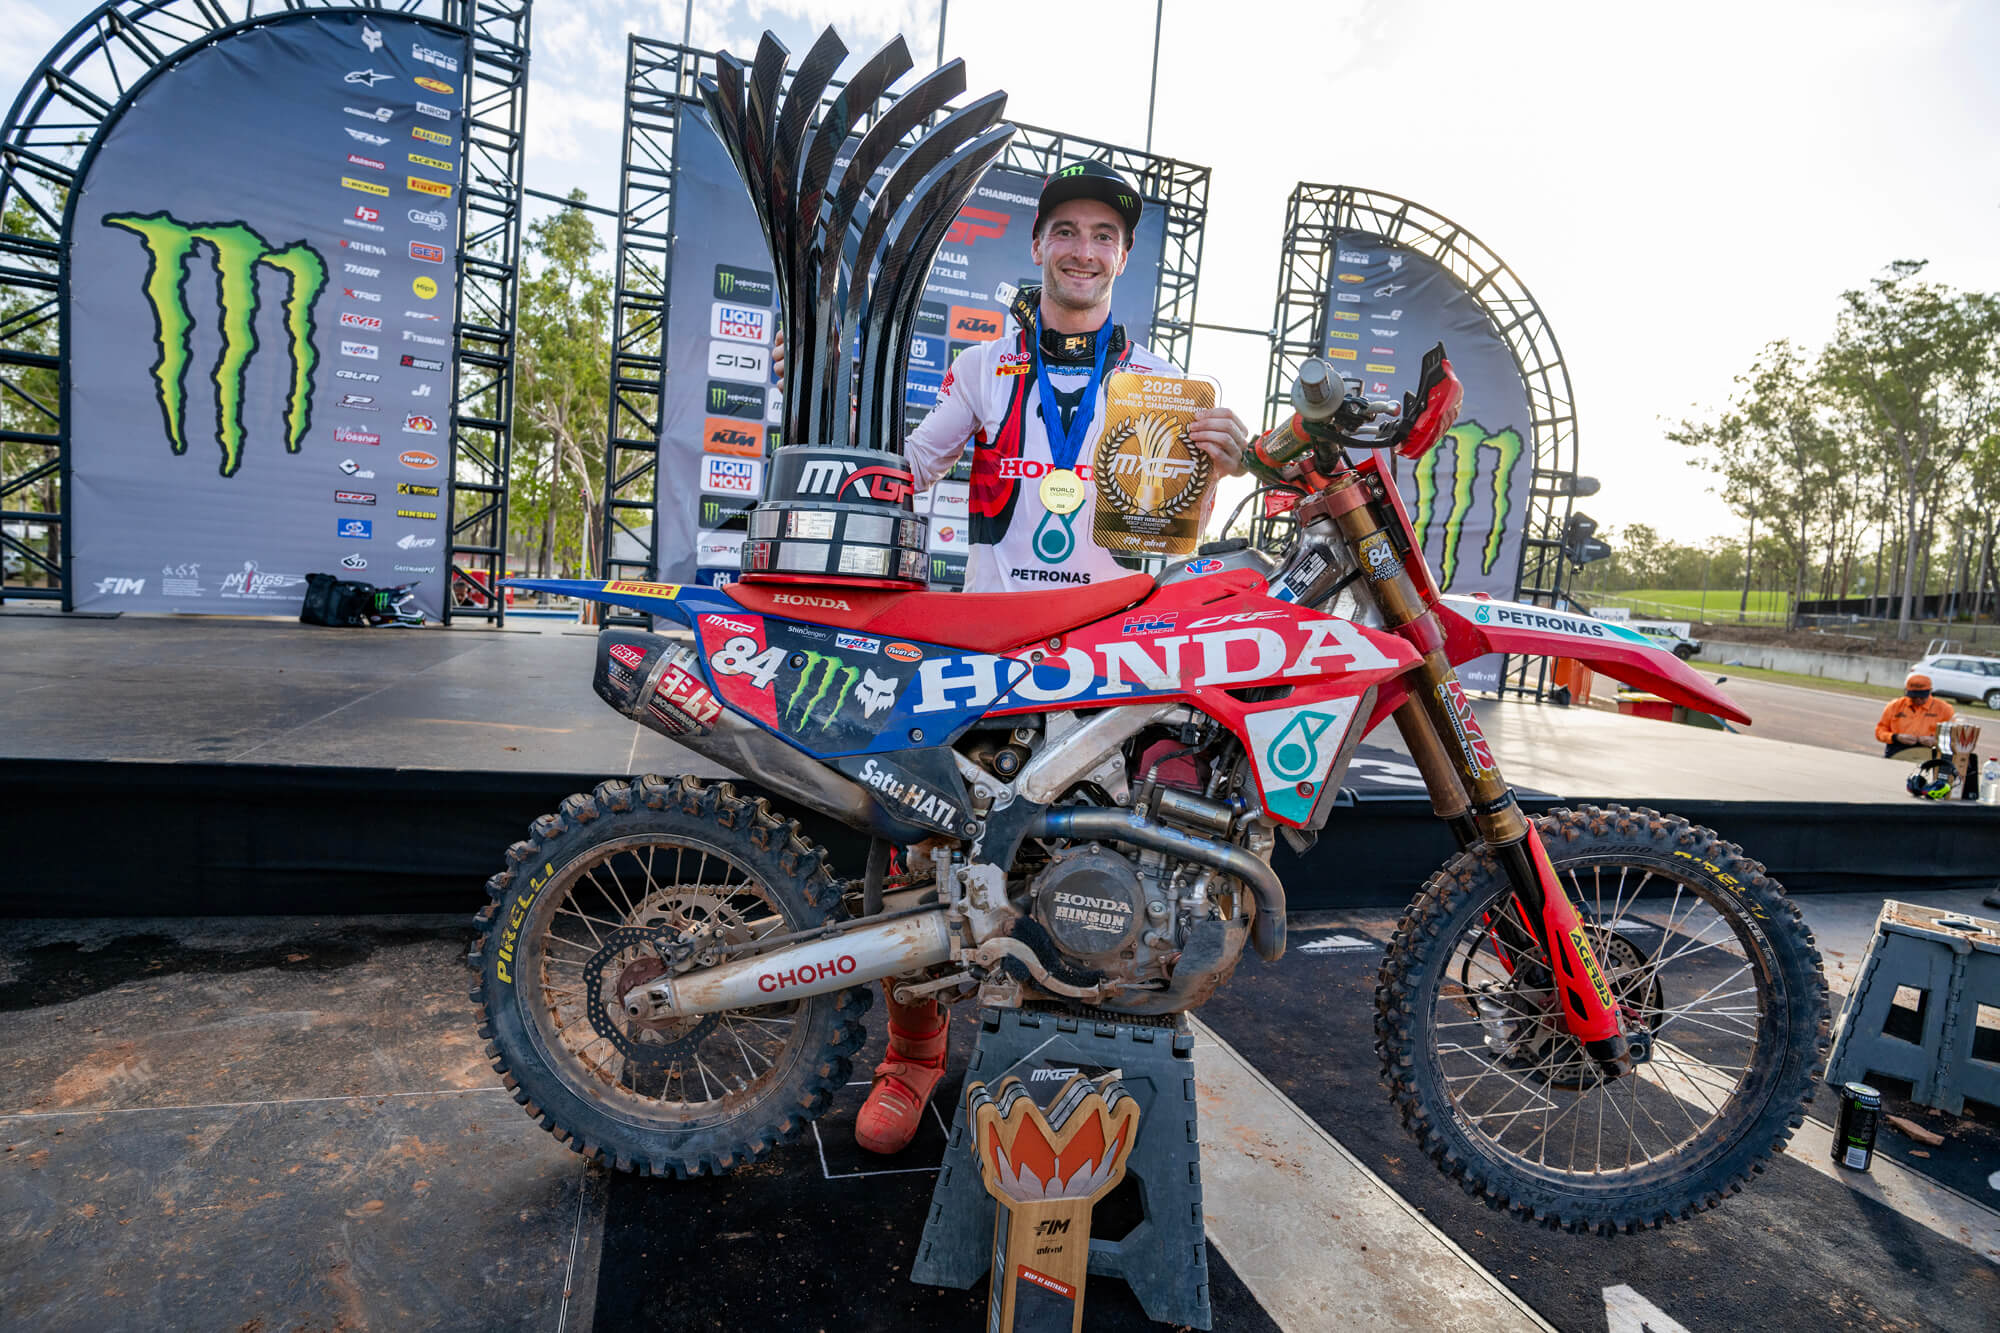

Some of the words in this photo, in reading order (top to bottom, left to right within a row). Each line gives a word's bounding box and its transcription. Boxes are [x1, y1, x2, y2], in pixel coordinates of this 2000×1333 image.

[344, 263, 380, 278] THOR
[720, 308, 763, 326] LIQUI
[957, 317, 997, 334] KTM
[720, 321, 762, 339] MOLY
[1065, 335, 1087, 349] 84
[716, 353, 761, 370] SIDI
[1142, 380, 1183, 395] 2026
[711, 429, 756, 447] KTM
[710, 460, 752, 478] LIQUI
[1109, 453, 1196, 480] MXGP
[710, 474, 751, 491] MOLY
[397, 510, 437, 520] HINSON
[1368, 542, 1393, 567] 84
[1189, 560, 1211, 574] VP
[1011, 568, 1091, 585] PETRONAS
[94, 577, 146, 595] FIM
[611, 581, 673, 597] PIRELLI
[773, 593, 852, 612] HONDA
[706, 615, 757, 633] MXGP
[1498, 609, 1604, 637] PETRONAS
[837, 636, 878, 650] VERTEX
[888, 646, 906, 655] Twin
[906, 650, 921, 658] Air
[710, 636, 788, 690] 84
[913, 620, 1399, 713] HONDA
[1446, 680, 1497, 770] KYB
[858, 759, 905, 799] Satu
[1053, 891, 1133, 914] HONDA
[497, 862, 554, 984] PIRELLI
[1055, 906, 1126, 928] HINSON
[758, 955, 857, 993] CHOHO
[1570, 931, 1611, 1008] ACERBIS
[1031, 1068, 1080, 1081] MXGP
[1033, 1219, 1071, 1235] FIM
